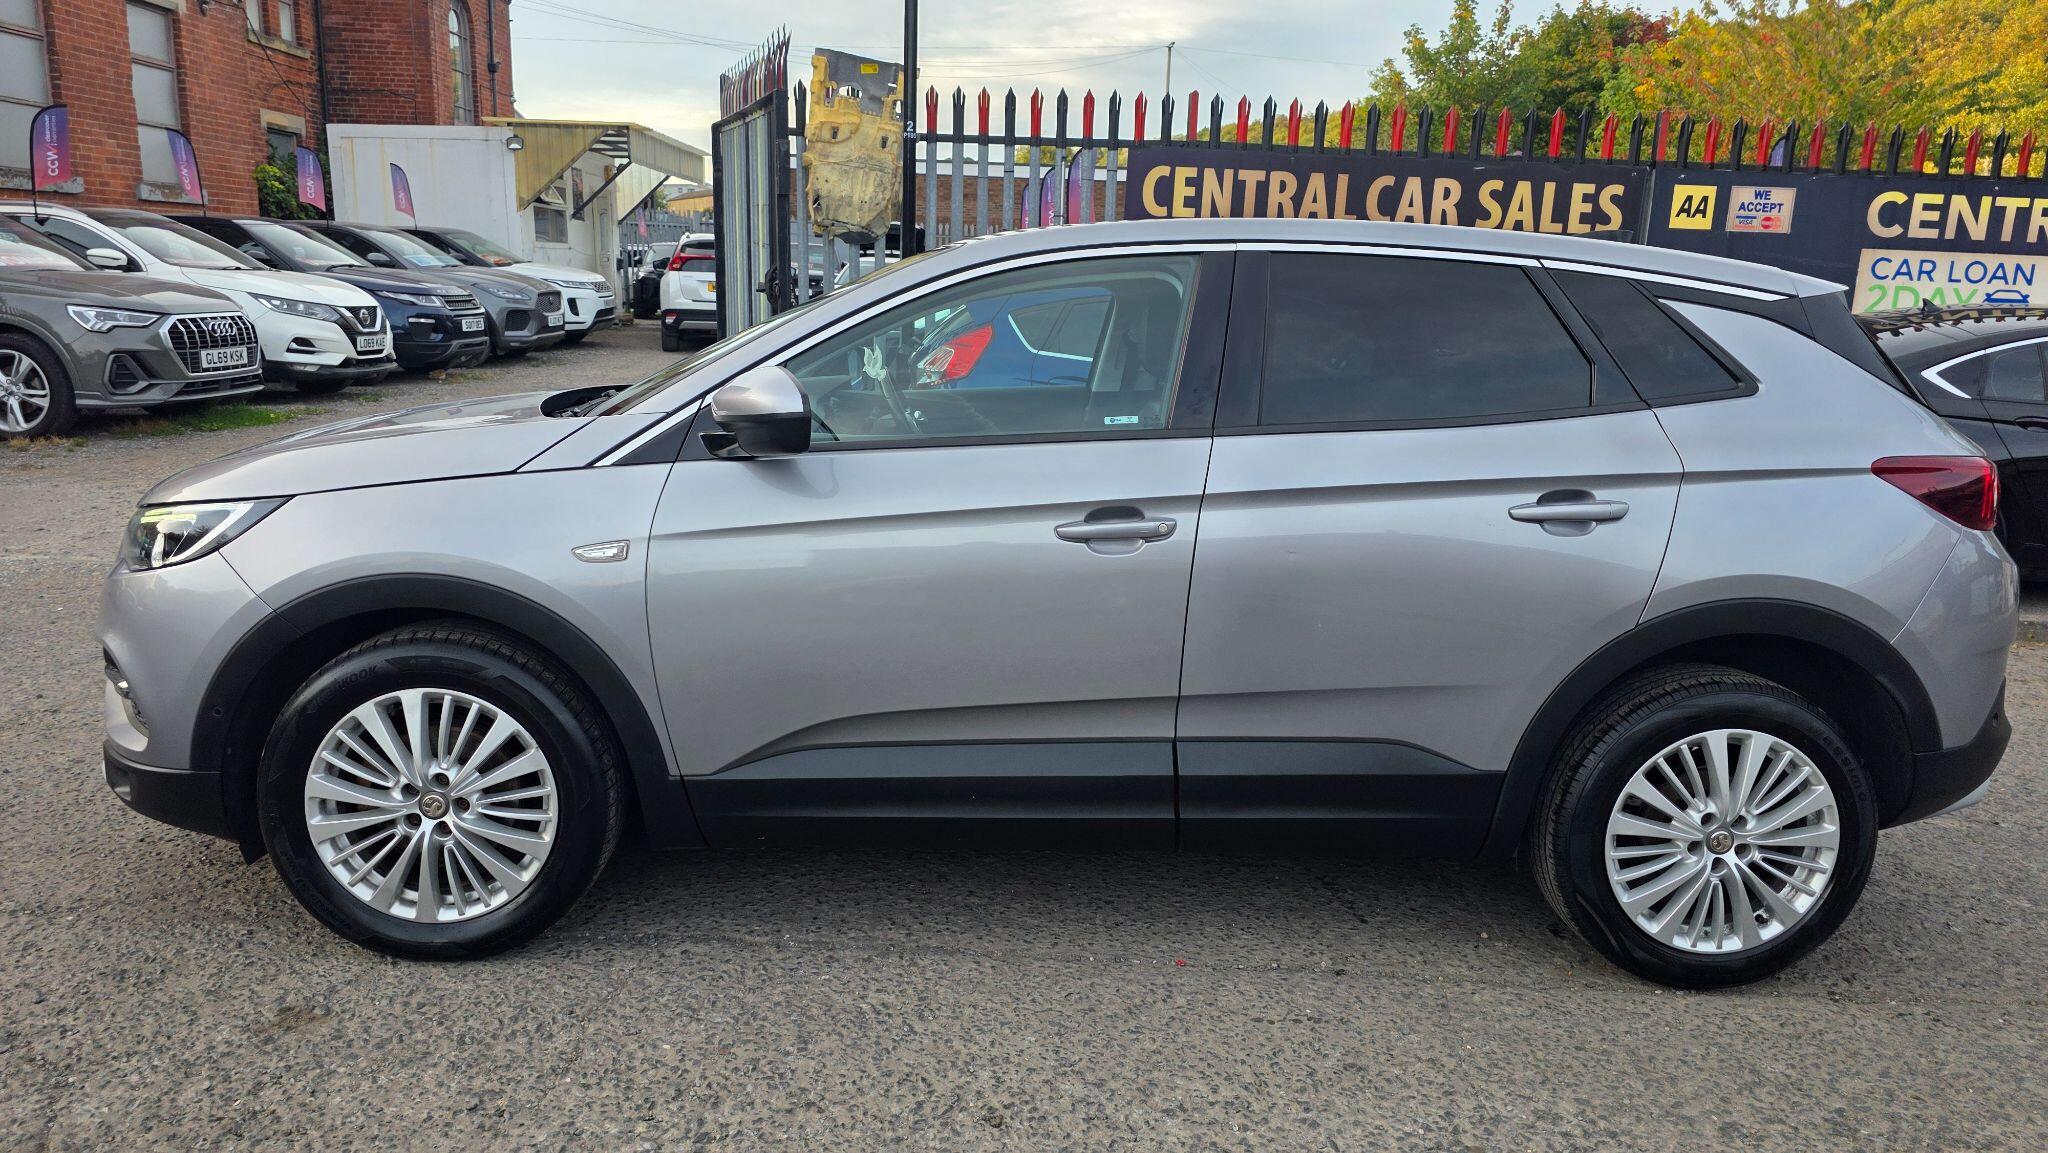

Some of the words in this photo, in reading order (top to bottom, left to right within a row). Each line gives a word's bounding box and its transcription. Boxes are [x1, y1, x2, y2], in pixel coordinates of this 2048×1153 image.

[906, 120, 914, 132] 2
[46, 144, 58, 176] CCW
[1142, 165, 1357, 220] CENTRAL
[1366, 175, 1463, 226] CAR
[1475, 179, 1625, 234] SALES
[1754, 190, 1771, 201] WE
[1675, 194, 1710, 219] AA
[1738, 202, 1784, 214] ACCEPT
[1871, 257, 1937, 282] CAR
[1948, 260, 2036, 286] LOAN
[205, 351, 229, 365] GL69
[229, 350, 245, 362] KSK
